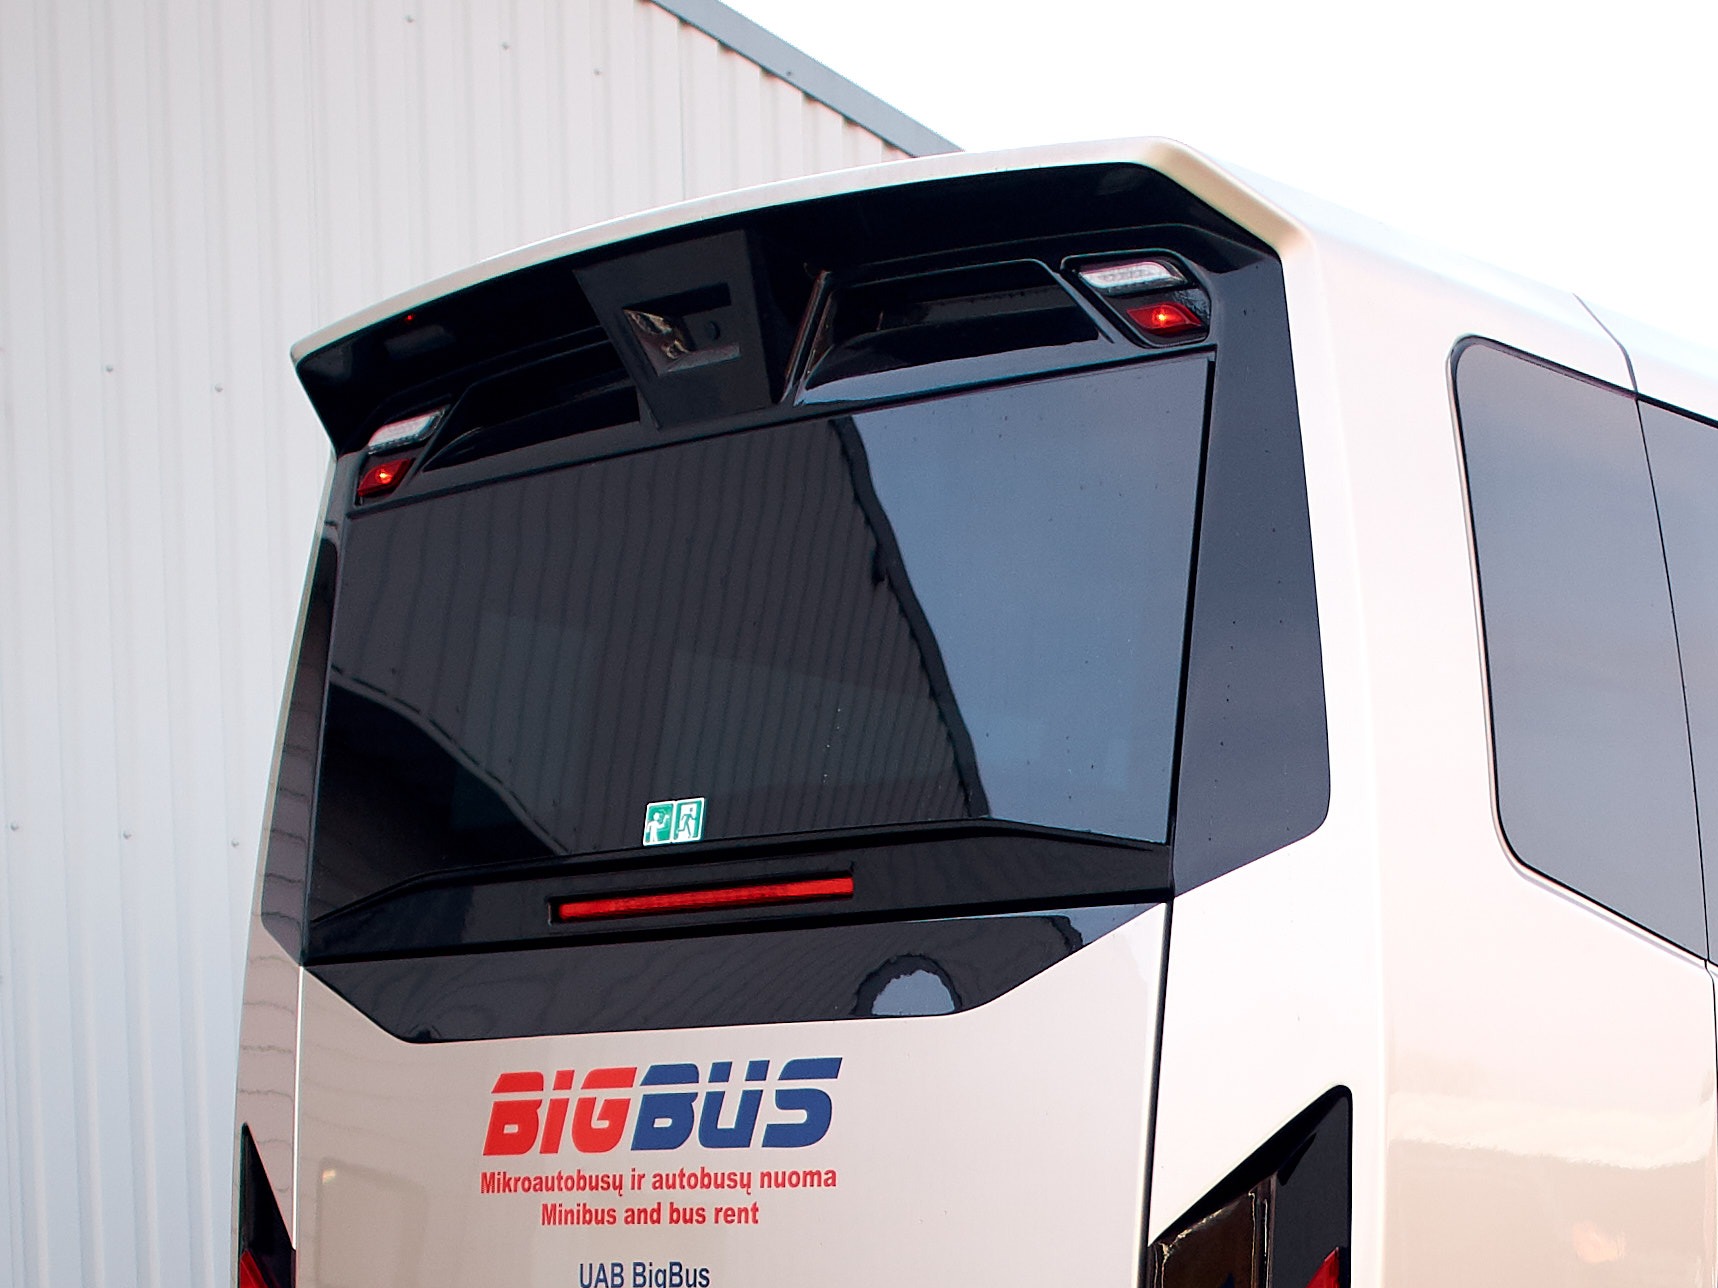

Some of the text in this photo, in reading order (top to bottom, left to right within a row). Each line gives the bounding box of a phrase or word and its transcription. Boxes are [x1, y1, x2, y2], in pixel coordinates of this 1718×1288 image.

[482, 1057, 843, 1156] BIGBUS
[480, 1166, 837, 1197] Mikroautobusų ir autobusų nuoma
[541, 1202, 759, 1226] Minibus and bus rent
[579, 1262, 624, 1288] UAB
